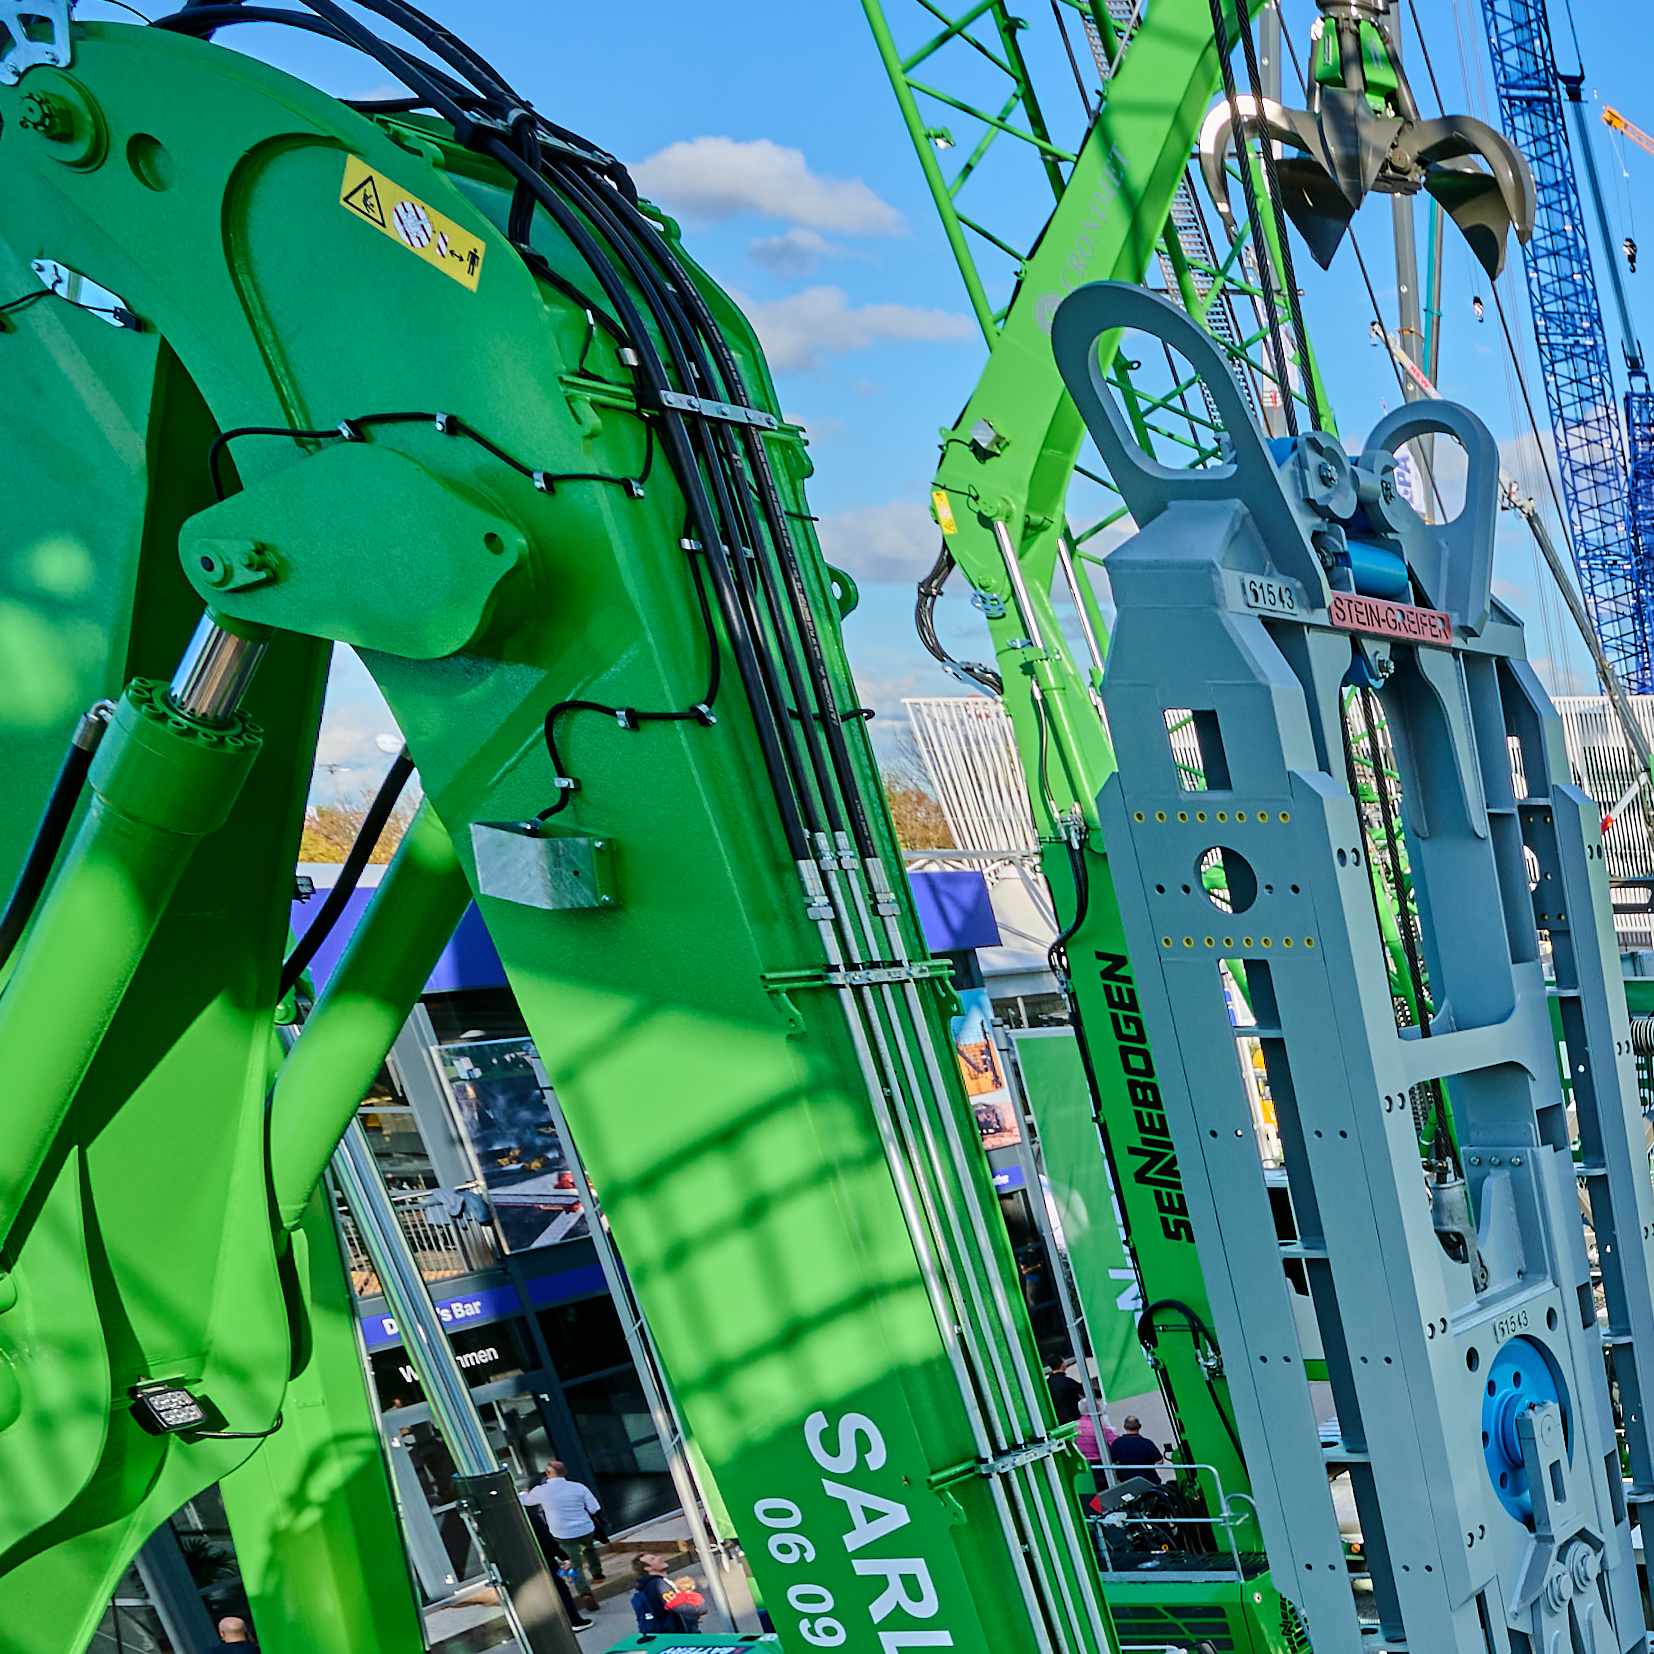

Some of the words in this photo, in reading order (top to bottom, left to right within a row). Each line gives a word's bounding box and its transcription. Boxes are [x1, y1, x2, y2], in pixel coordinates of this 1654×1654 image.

[1248, 580, 1295, 610] 61543
[1333, 597, 1450, 640] STEIN-GREIFER
[1094, 950, 1195, 1243] SENNEBOGEN
[450, 1299, 482, 1321] Bar
[753, 1497, 817, 1565] 06
[787, 1584, 847, 1648] 09
